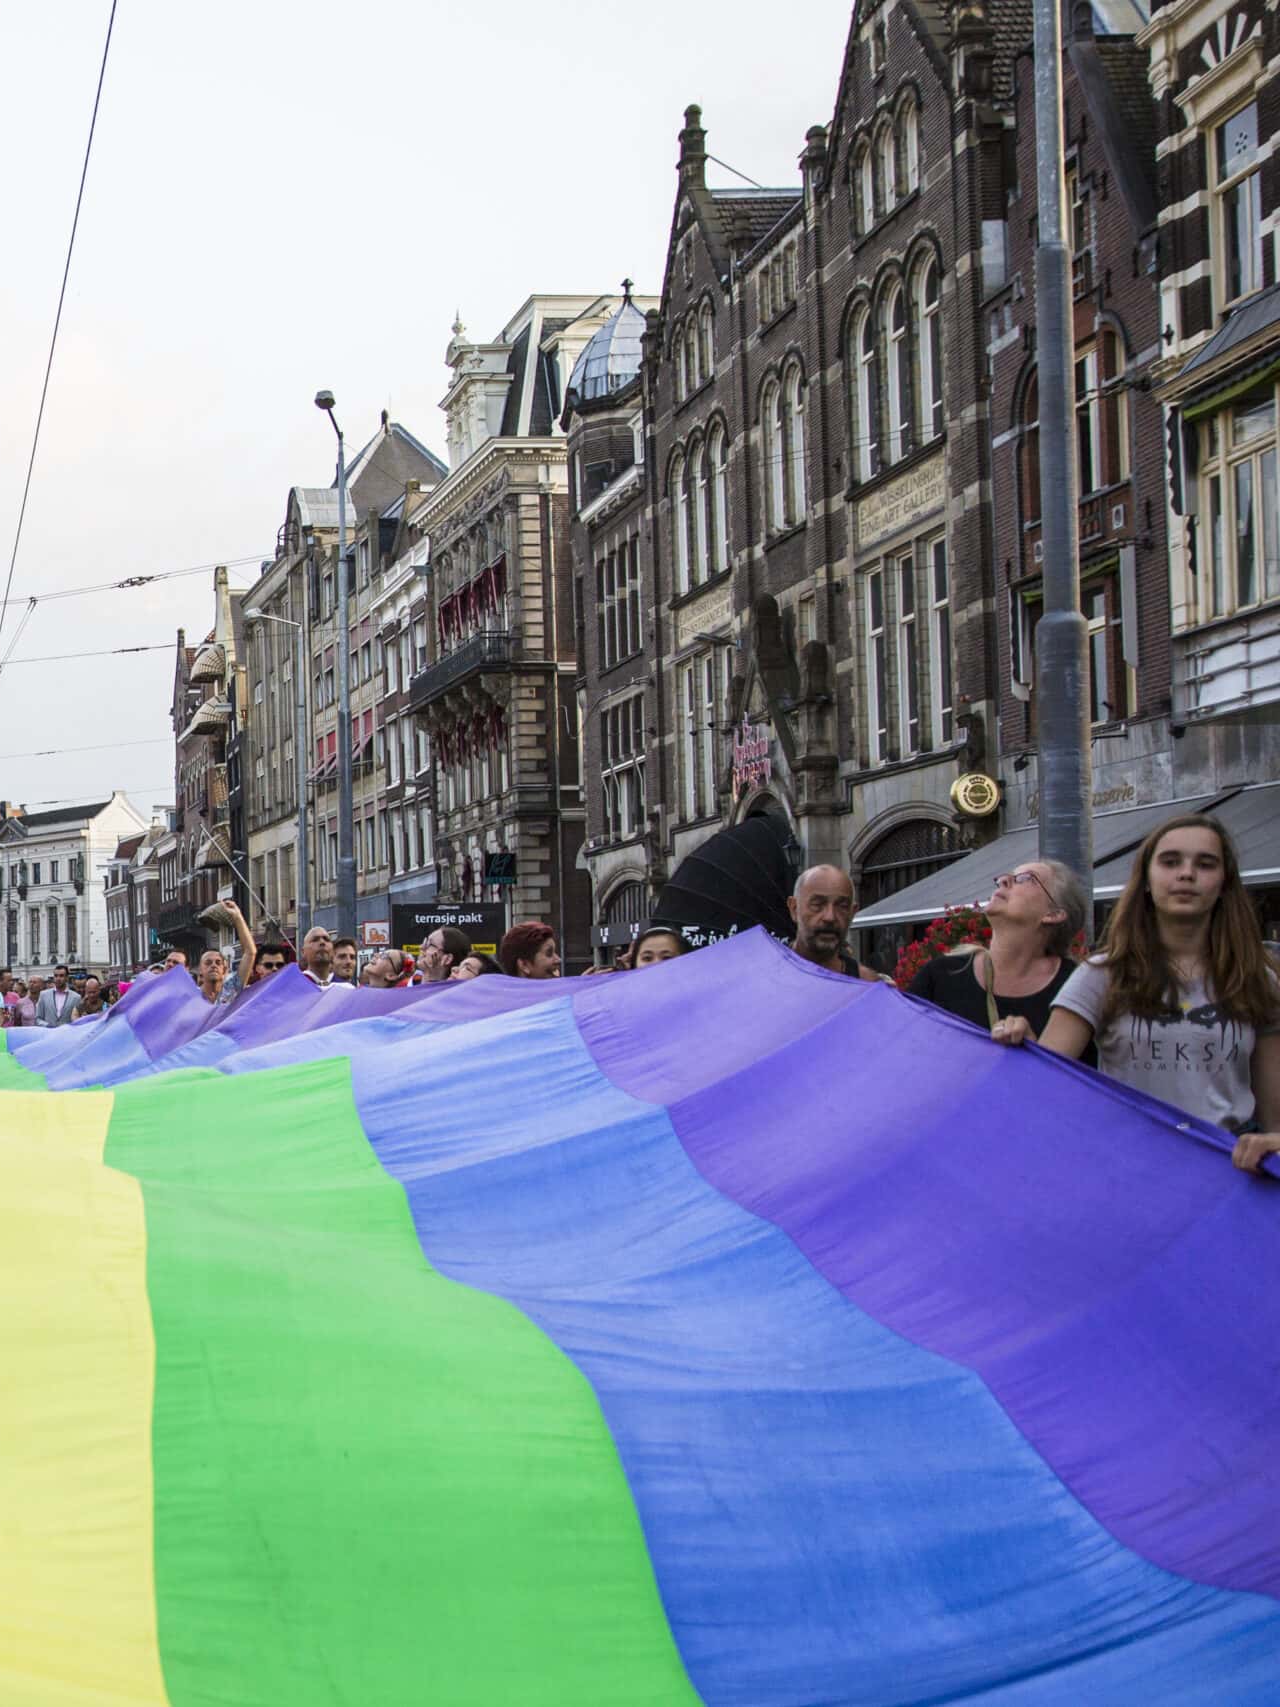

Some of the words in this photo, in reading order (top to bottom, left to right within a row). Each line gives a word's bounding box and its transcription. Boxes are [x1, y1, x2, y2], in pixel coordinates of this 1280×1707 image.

[415, 912, 456, 925] terrasje
[458, 912, 483, 925] pakt
[1130, 1041, 1239, 1062] LEKSA
